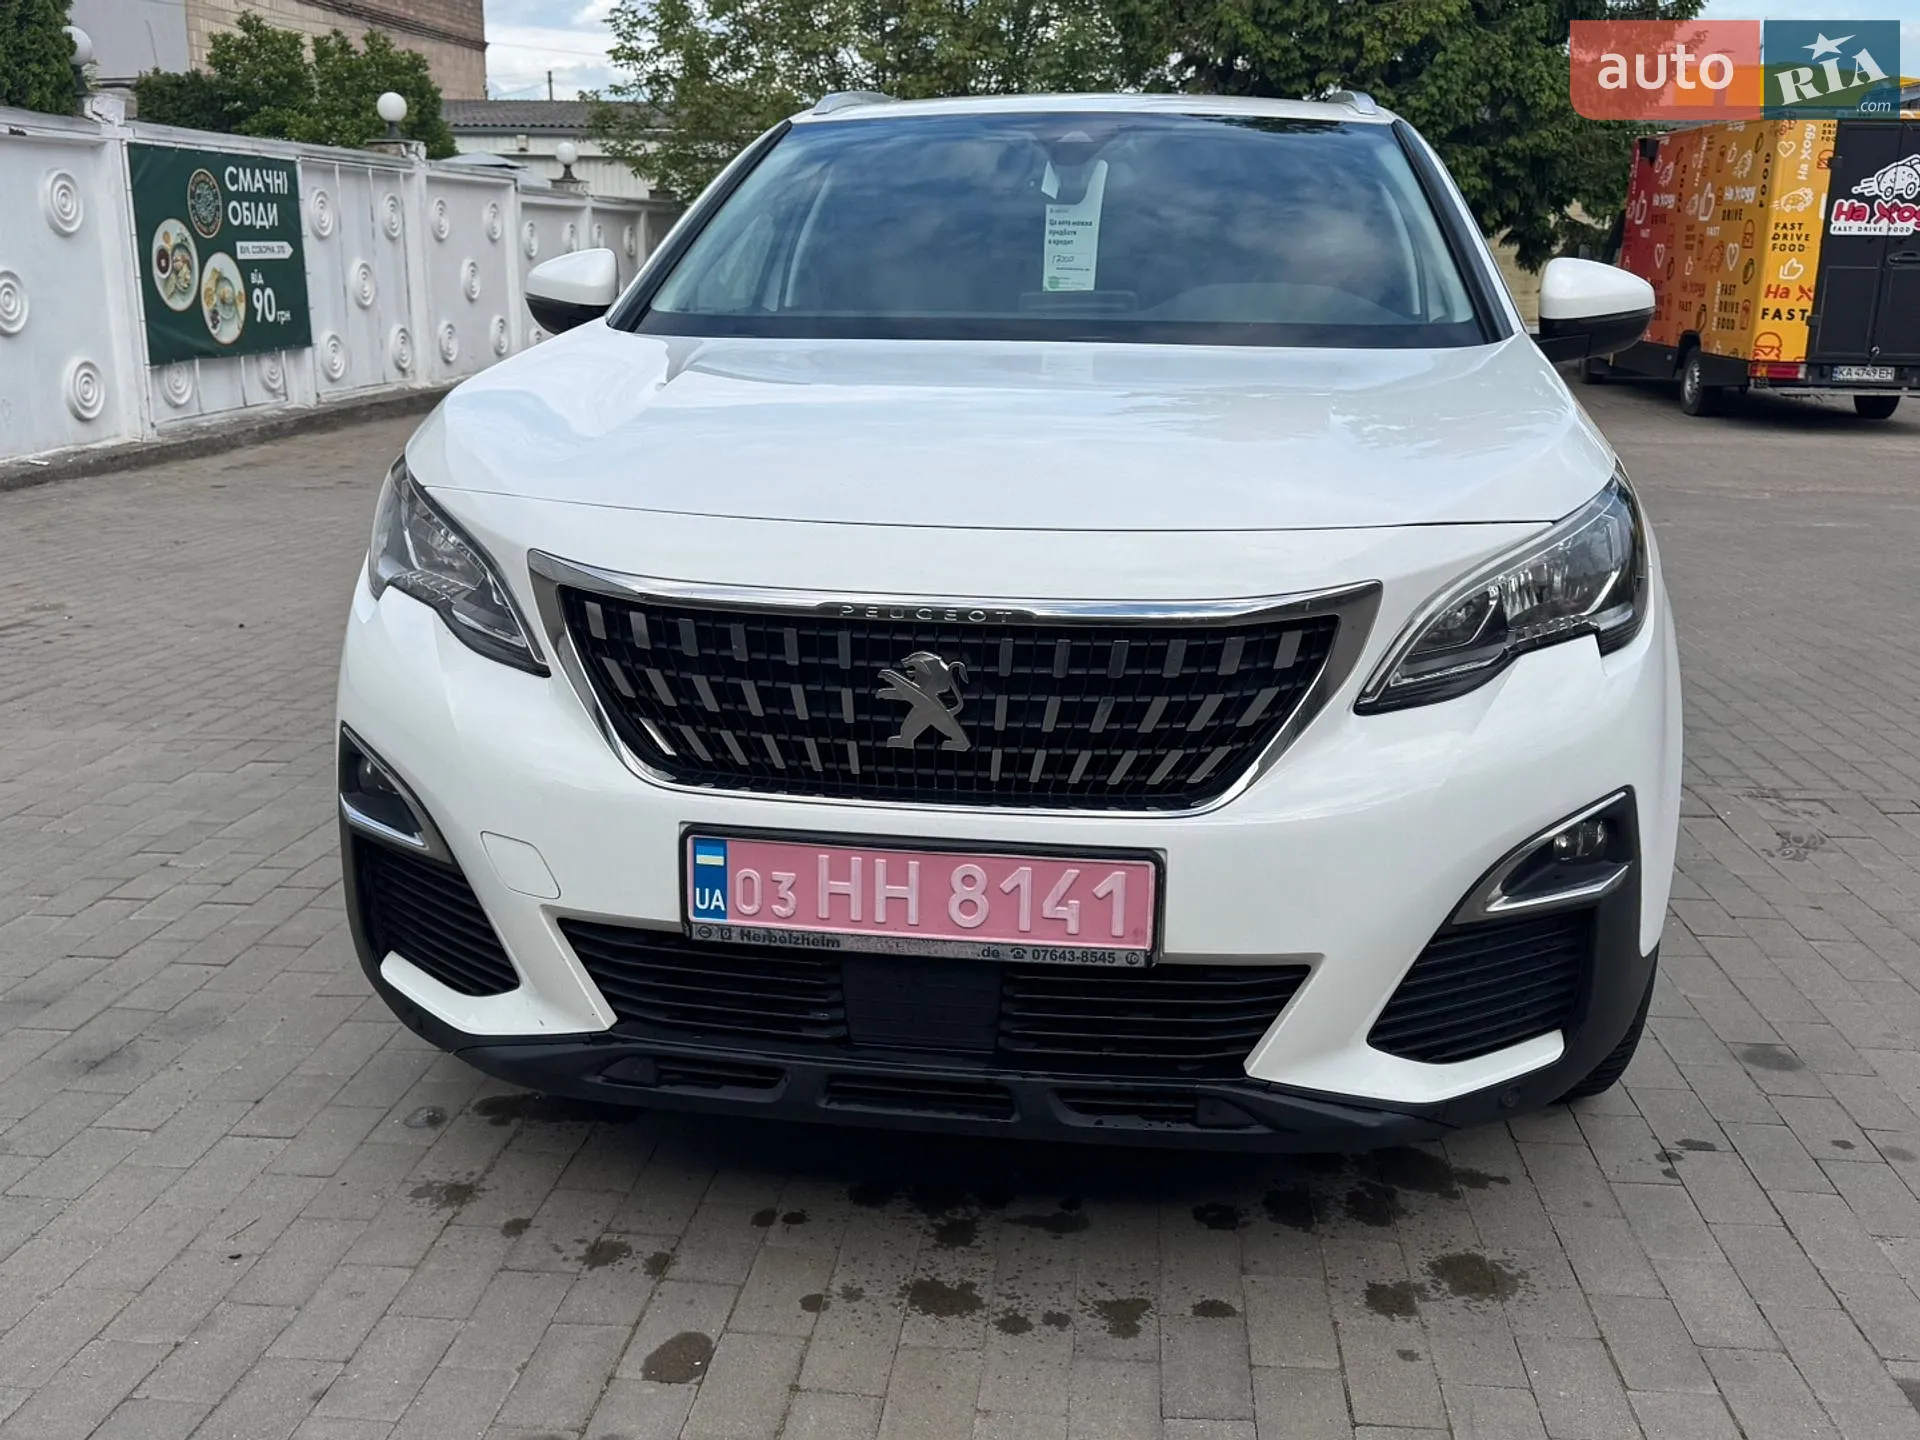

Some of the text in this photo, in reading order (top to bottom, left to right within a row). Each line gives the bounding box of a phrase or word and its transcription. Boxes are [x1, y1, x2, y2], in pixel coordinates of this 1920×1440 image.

[224, 166, 289, 195] СМАЧНІ
[227, 200, 278, 230] ОБІДИ
[1773, 222, 1804, 232] FAST
[1770, 232, 1811, 242] DRIVE
[1770, 243, 1806, 252] FOOD
[252, 287, 276, 323] 90
[1760, 308, 1809, 321] FAST
[839, 604, 1013, 623] PEUGEOT
[695, 887, 726, 912] UA
[733, 853, 1127, 938] 03 HH 8141
[739, 927, 842, 949] Herbolzheim
[1030, 948, 1116, 965] 07643-8545
